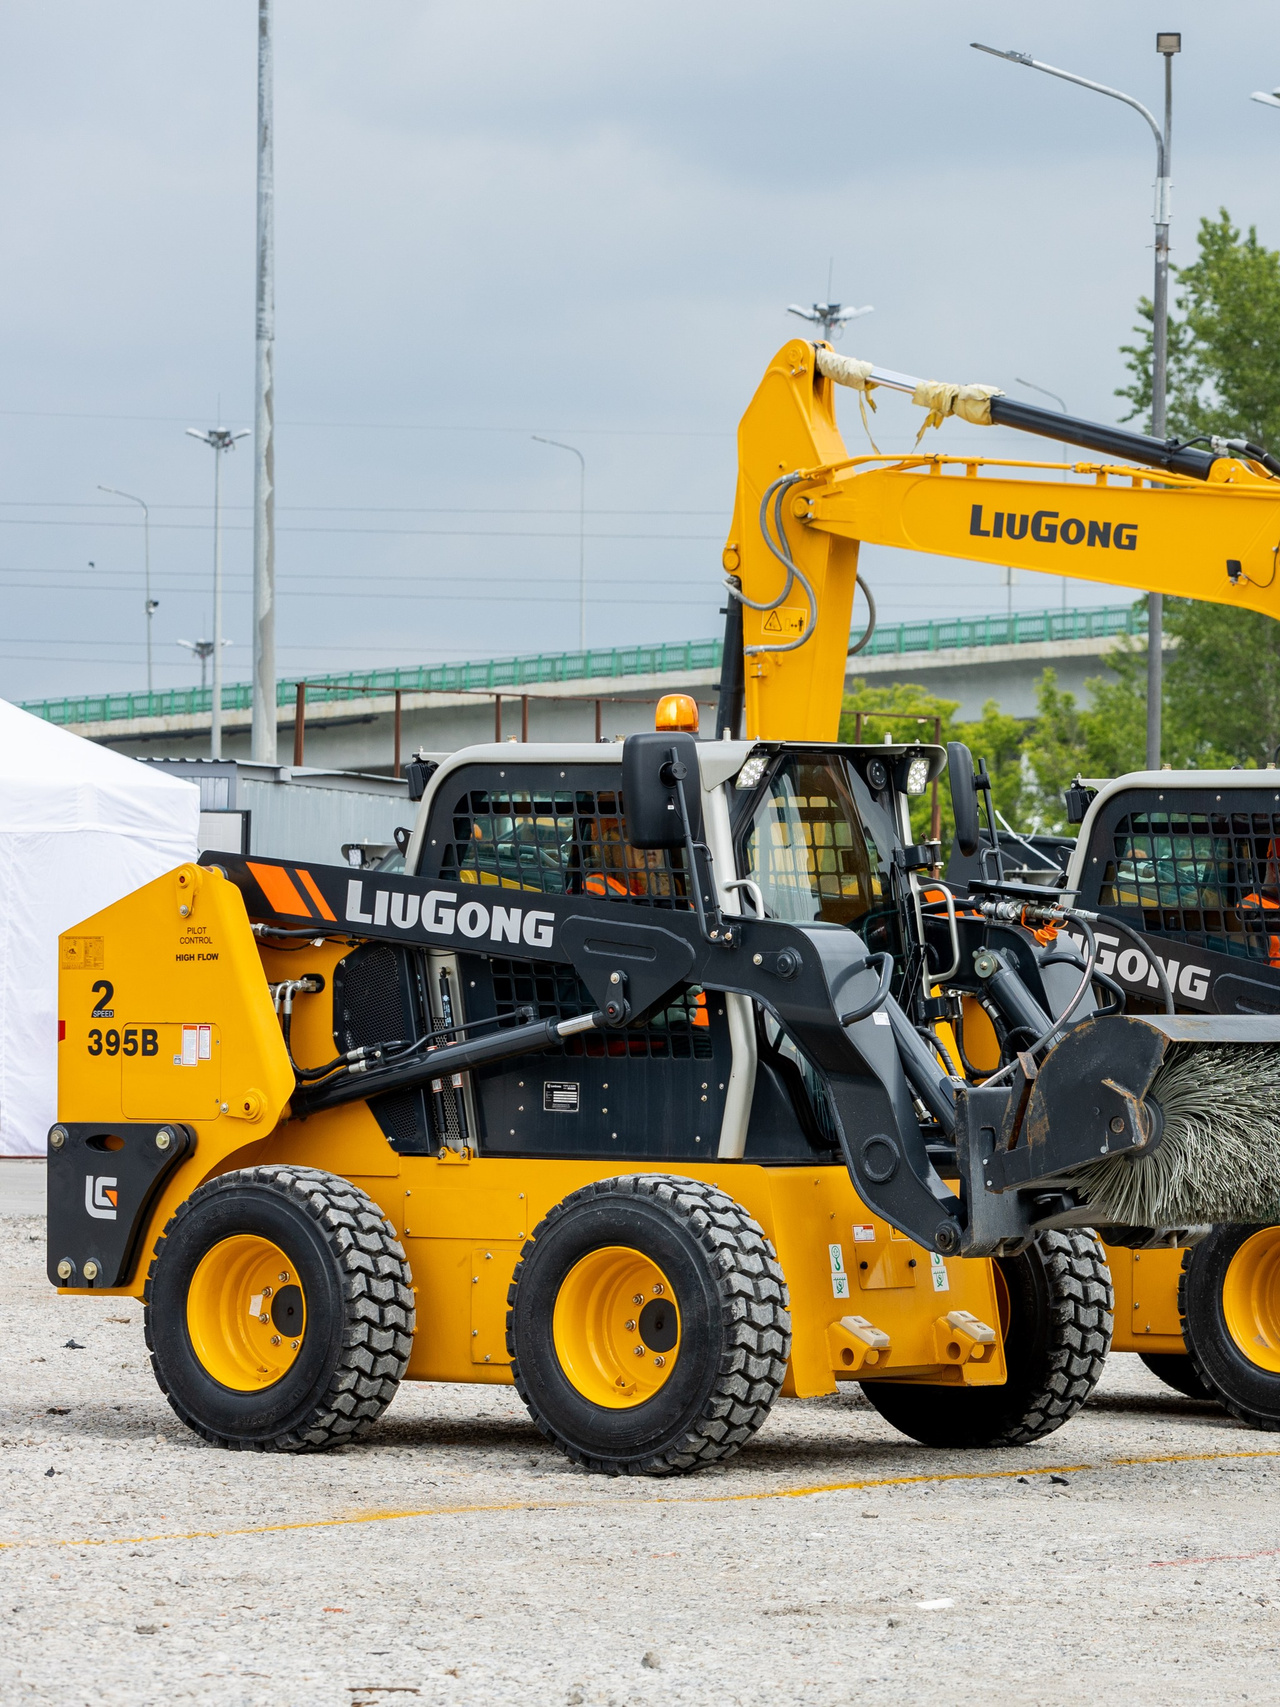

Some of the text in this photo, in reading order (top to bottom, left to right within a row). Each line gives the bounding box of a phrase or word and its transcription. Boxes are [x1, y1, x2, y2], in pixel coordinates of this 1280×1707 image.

[187, 926, 207, 935] PILOT
[179, 936, 213, 945] CONTROL
[197, 953, 219, 961] FLOW
[1067, 928, 1212, 1001] GONG
[91, 979, 115, 1018] 2
[92, 1010, 114, 1018] SPEED
[87, 1028, 159, 1057] 395B
